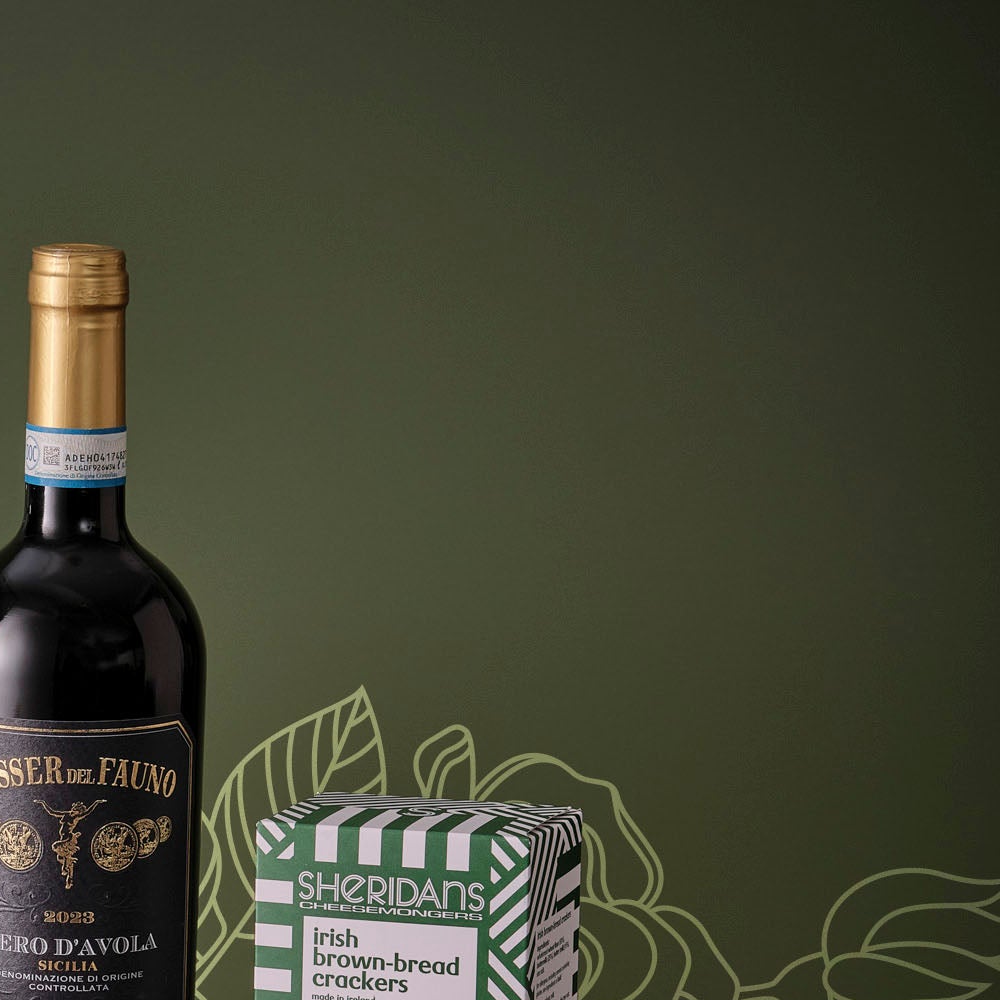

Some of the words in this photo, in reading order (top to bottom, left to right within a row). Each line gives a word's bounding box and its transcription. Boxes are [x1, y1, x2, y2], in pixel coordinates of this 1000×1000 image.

[66, 768, 96, 785] DEL
[97, 756, 177, 798] FAUNO
[43, 910, 95, 924] 2023
[300, 901, 483, 921] CHEESEMONGERS
[54, 932, 158, 956] D'AVOLA
[313, 927, 358, 948] irish
[38, 960, 98, 972] SICILIA
[313, 947, 460, 976] brown-bread
[101, 970, 144, 982] ORIGINE
[312, 971, 408, 994] crackers
[28, 983, 109, 992] CONTROLLATA
[311, 993, 334, 1000] made
